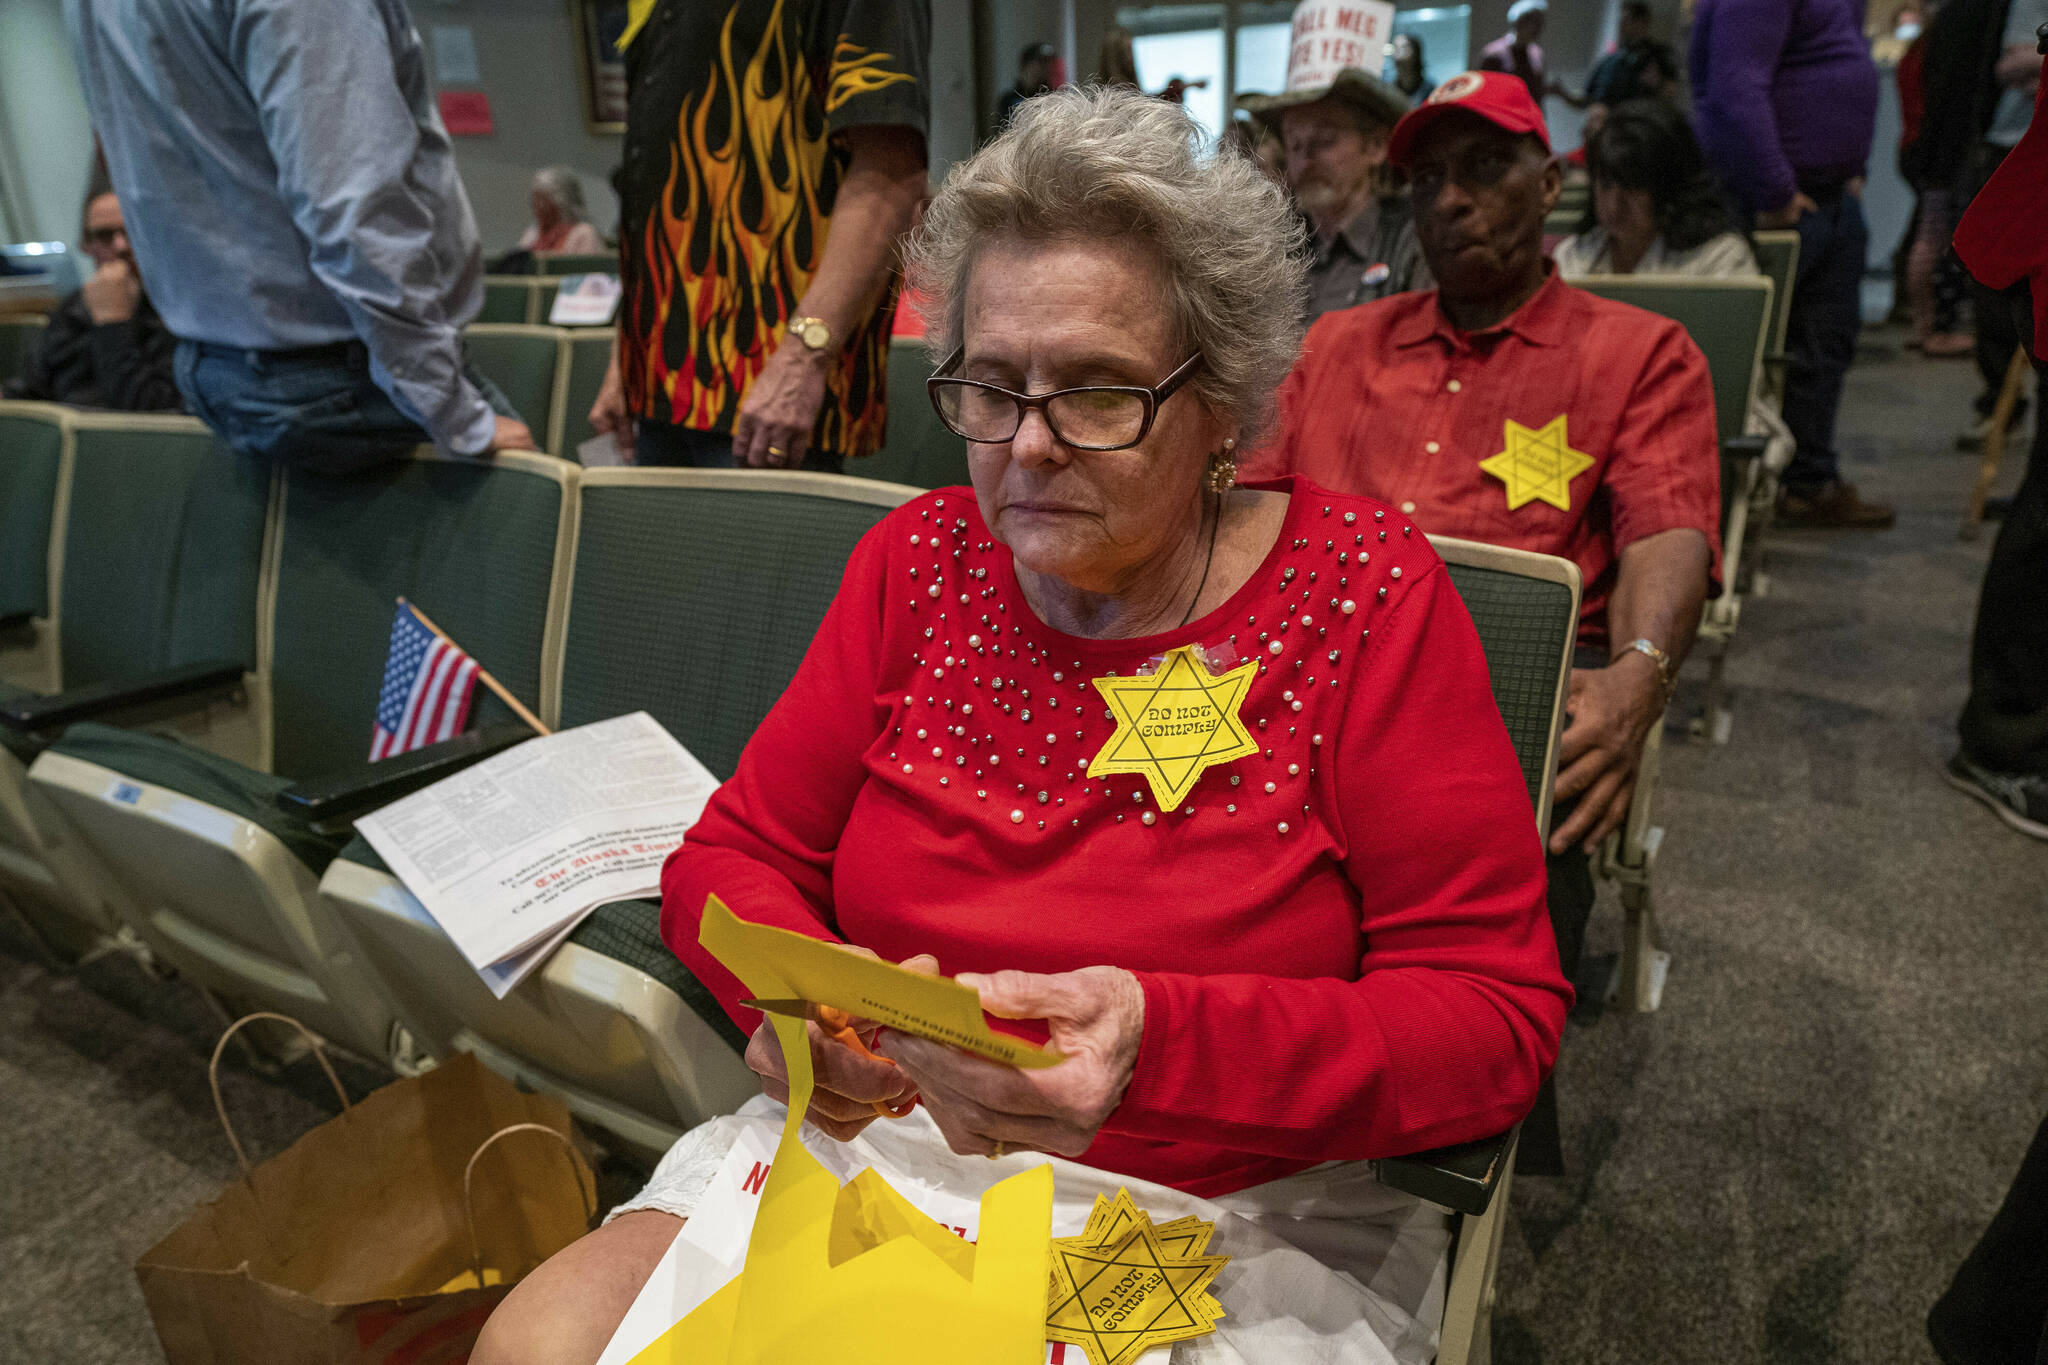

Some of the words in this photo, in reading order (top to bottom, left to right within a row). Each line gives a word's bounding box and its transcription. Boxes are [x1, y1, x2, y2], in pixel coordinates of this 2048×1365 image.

[1142, 719, 1216, 737] COMPLY
[1149, 708, 1172, 720] DO
[1177, 705, 1212, 719] NOT
[533, 867, 566, 889] The
[570, 847, 630, 869] Alaska
[1090, 1297, 1116, 1319] DO
[1110, 1267, 1144, 1298] NOT
[1103, 1272, 1164, 1331] COMPLY
